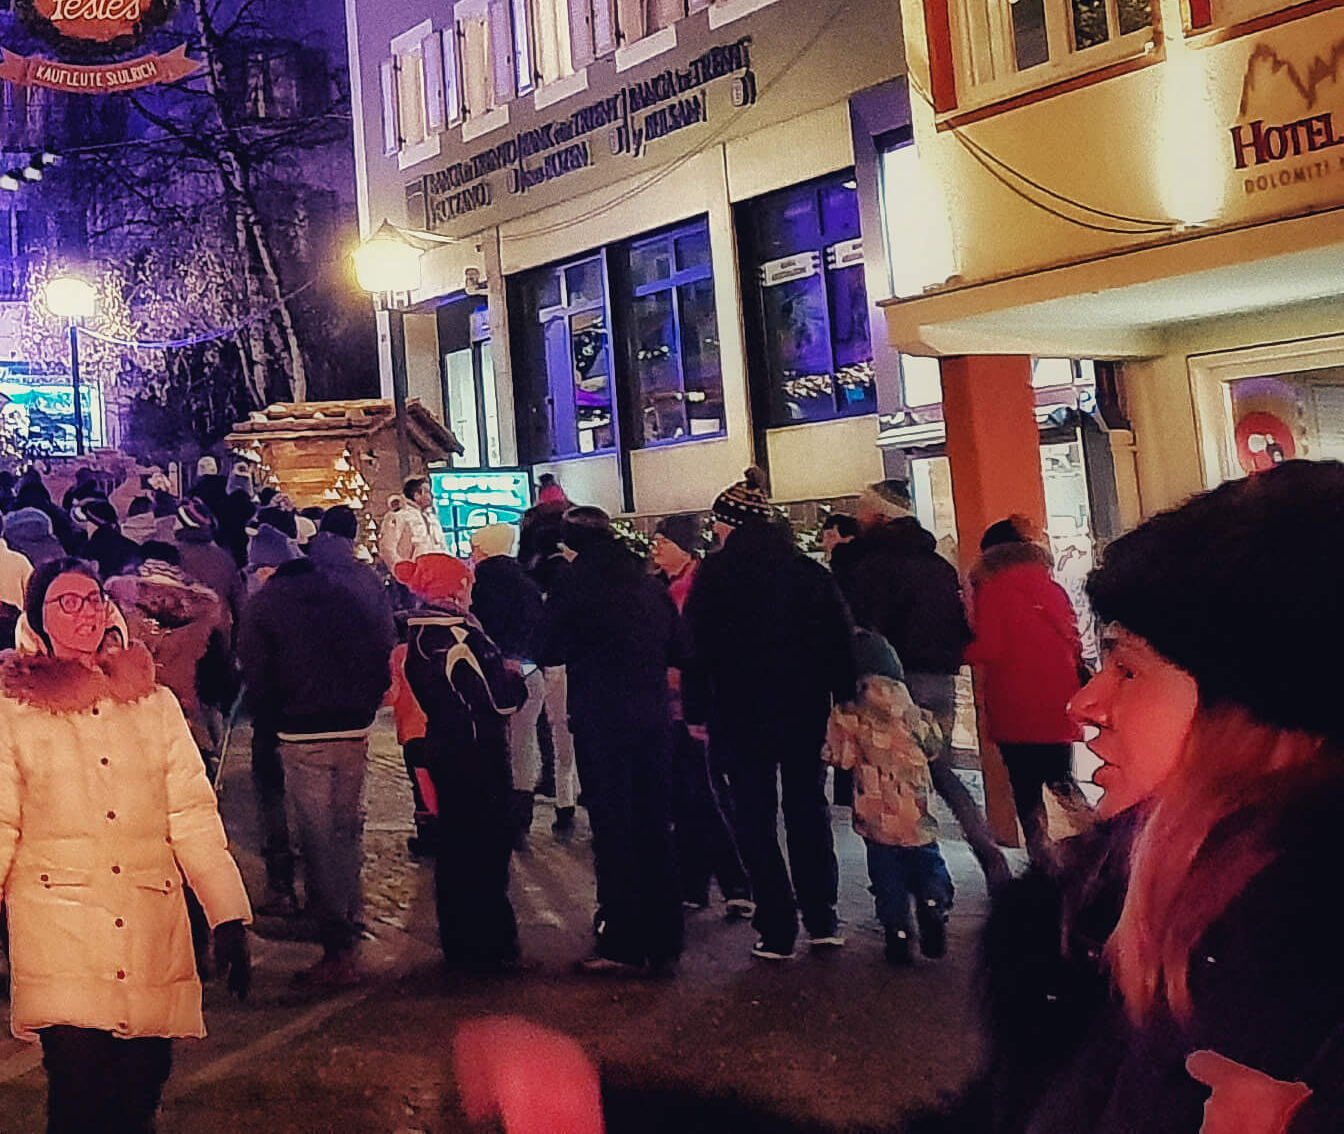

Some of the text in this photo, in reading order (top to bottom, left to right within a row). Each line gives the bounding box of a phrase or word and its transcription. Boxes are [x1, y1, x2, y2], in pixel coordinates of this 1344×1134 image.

[36, 65, 104, 87] KAUFLEUTE
[1229, 112, 1344, 170] HOTEL
[1244, 160, 1329, 194] DOLOMITI
